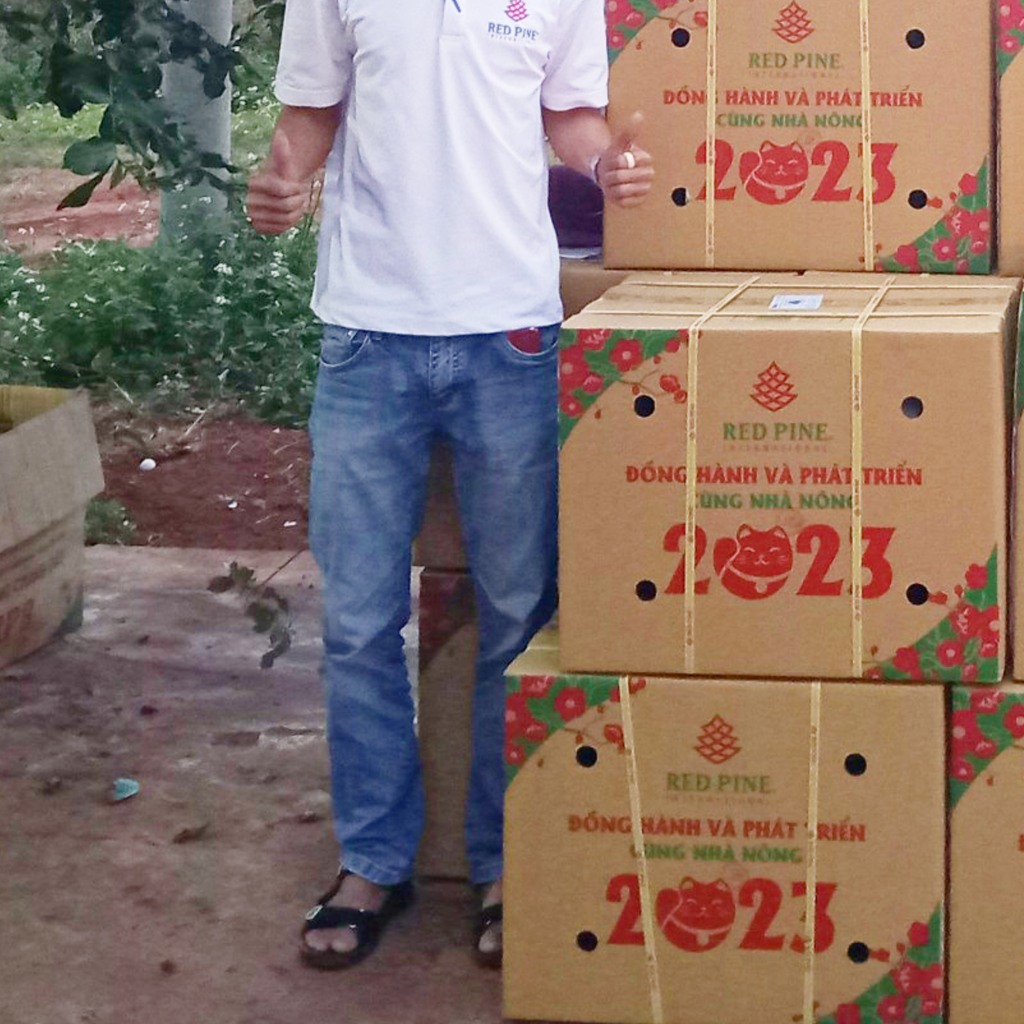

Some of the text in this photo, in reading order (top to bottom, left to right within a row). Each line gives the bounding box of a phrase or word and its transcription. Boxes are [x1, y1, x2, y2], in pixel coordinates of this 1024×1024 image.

[488, 22, 511, 37] RED
[748, 53, 841, 70] RED PINE
[722, 422, 828, 442] RED PINE
[666, 773, 771, 794] RED PINE
